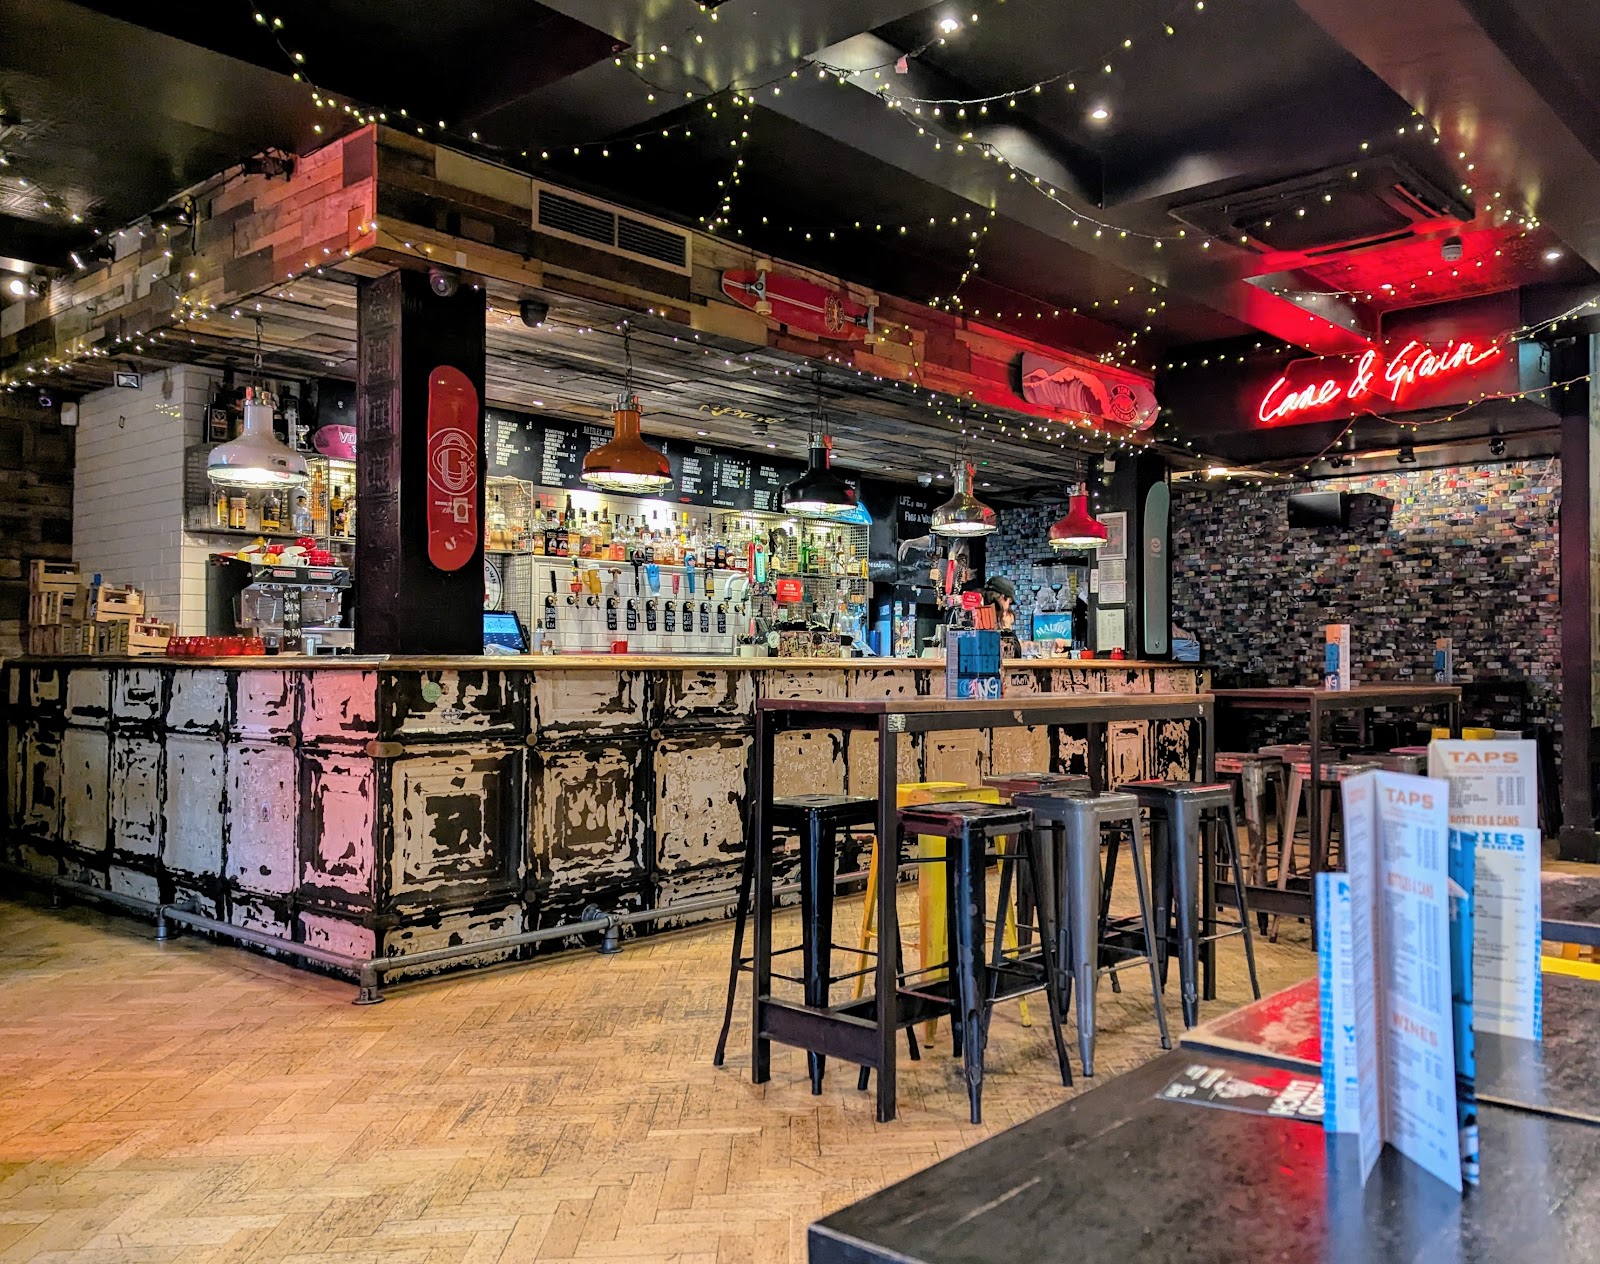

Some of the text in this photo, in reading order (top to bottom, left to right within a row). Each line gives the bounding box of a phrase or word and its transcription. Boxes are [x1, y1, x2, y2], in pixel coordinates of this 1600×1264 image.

[1347, 349, 1376, 399] &
[1385, 340, 1498, 401] Grain
[1036, 623, 1069, 637] MALIBU
[1448, 751, 1519, 764] TAPS
[1385, 788, 1434, 809] TAPS
[1489, 816, 1495, 826] &
[1497, 816, 1519, 827] CANS
[1393, 1012, 1438, 1048] WINES
